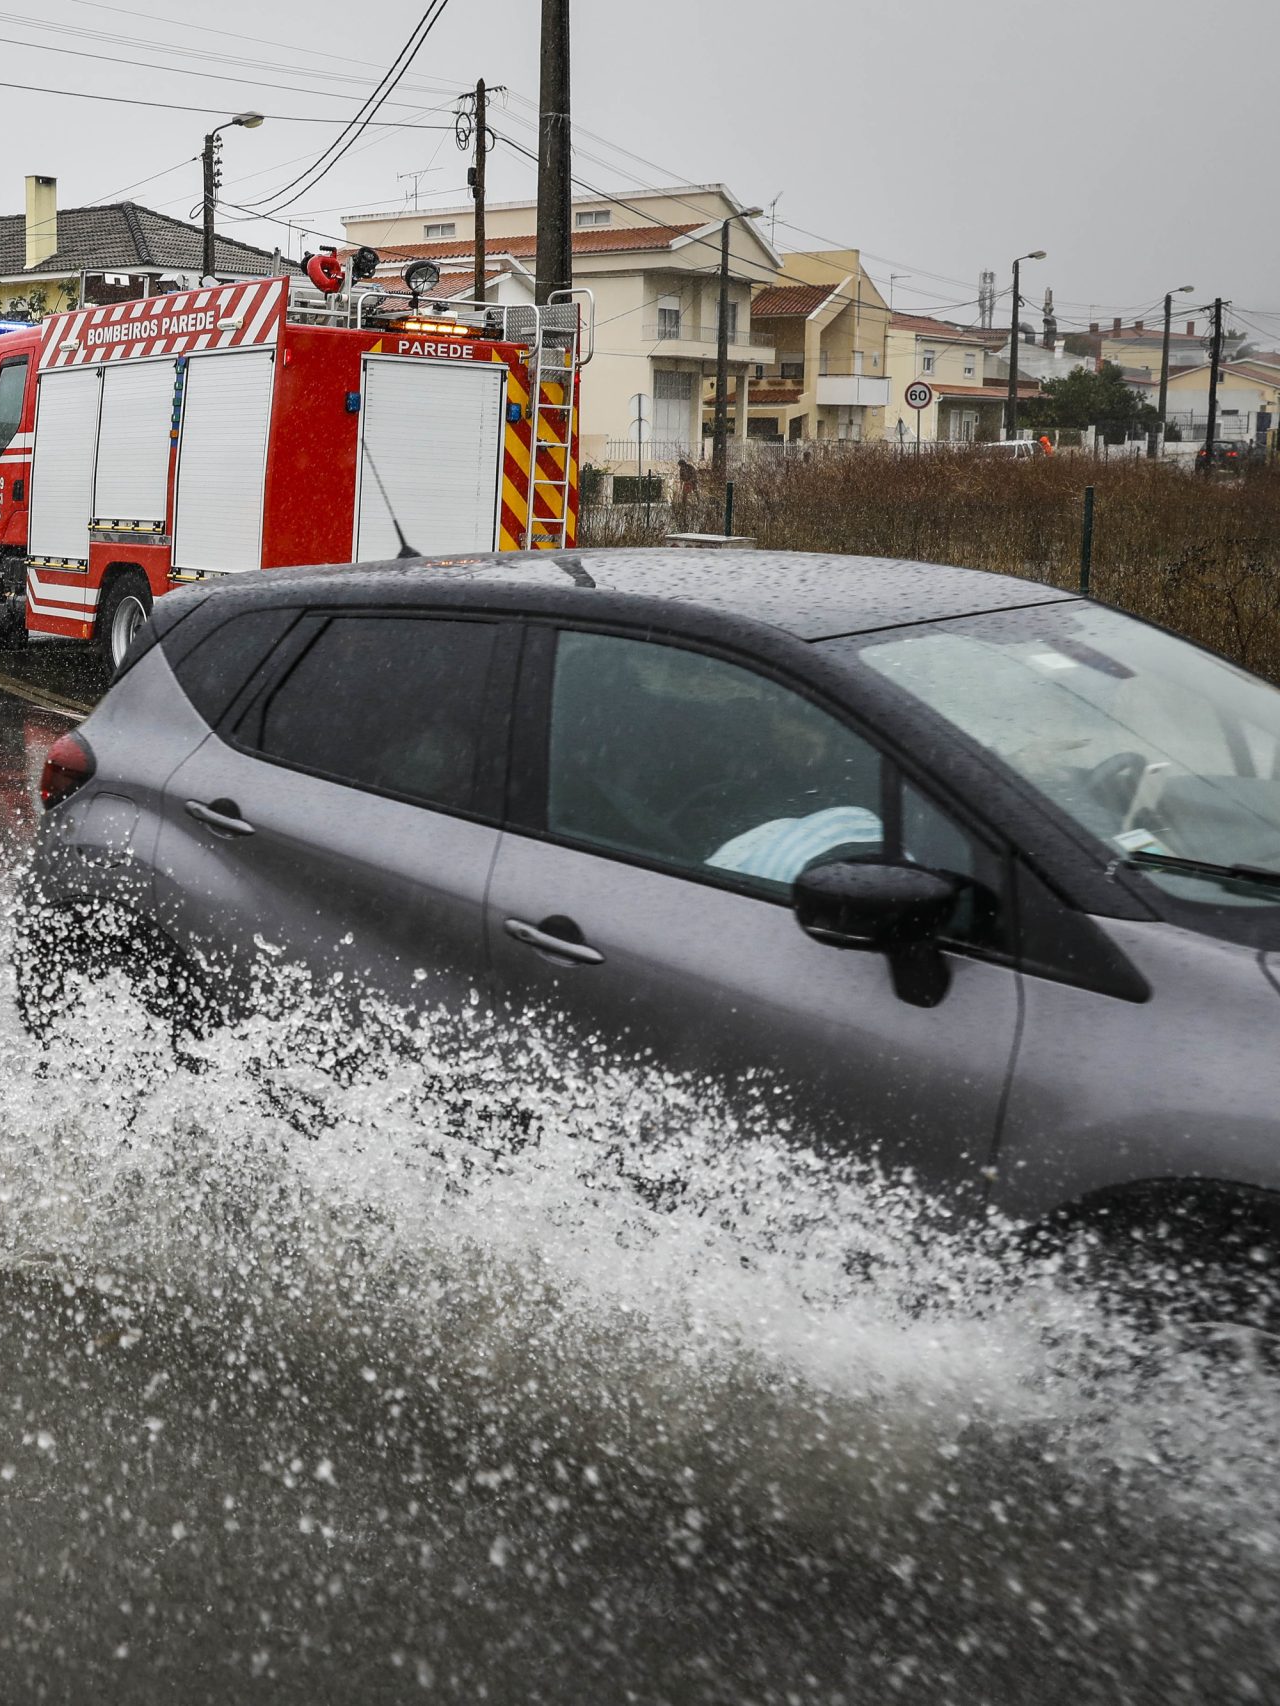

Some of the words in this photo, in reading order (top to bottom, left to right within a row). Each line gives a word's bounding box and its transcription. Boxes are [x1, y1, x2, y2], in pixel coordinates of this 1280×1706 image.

[87, 318, 158, 346] BOMBEIROS
[161, 310, 215, 336] PAREDE
[398, 340, 474, 359] PAREDE
[910, 390, 927, 401] 60
